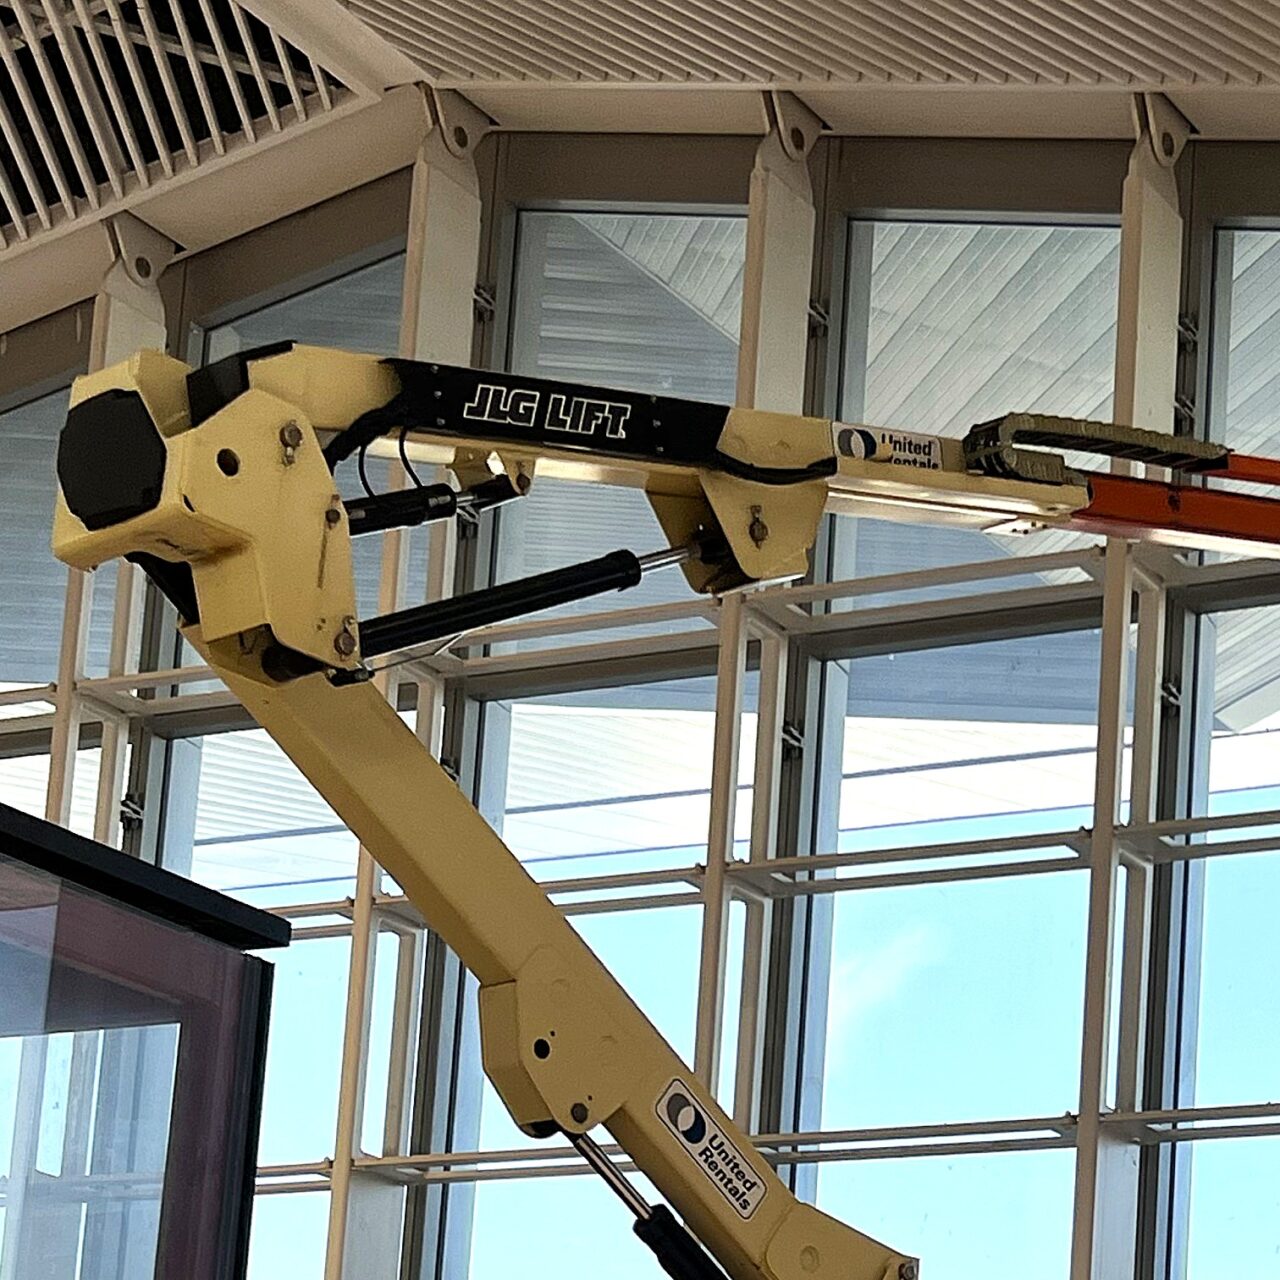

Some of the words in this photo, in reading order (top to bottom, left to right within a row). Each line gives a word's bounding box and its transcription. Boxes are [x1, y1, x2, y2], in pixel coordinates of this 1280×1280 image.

[463, 384, 540, 427] JLG
[545, 394, 632, 438] LIFT
[698, 1146, 751, 1211] Rentals
[708, 1134, 757, 1192] United
